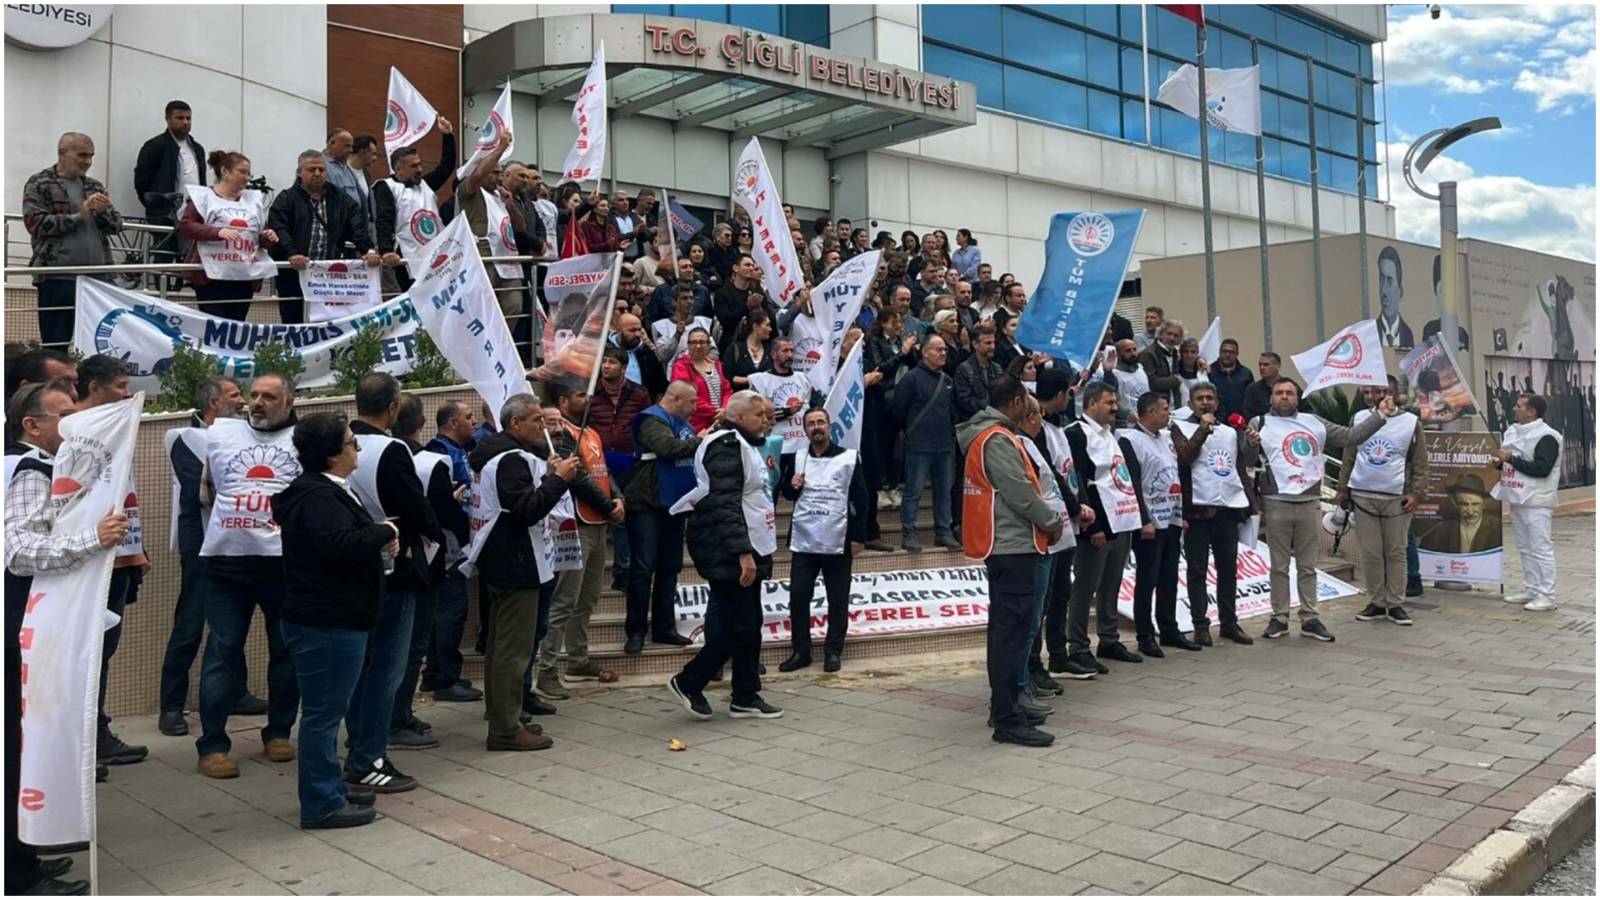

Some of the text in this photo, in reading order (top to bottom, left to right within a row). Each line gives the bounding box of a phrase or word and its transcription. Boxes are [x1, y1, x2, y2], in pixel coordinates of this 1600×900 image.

[646, 25, 961, 109] T.C. ÇİĞLİ BELEDİYESİ
[848, 606, 931, 622] YEREL
